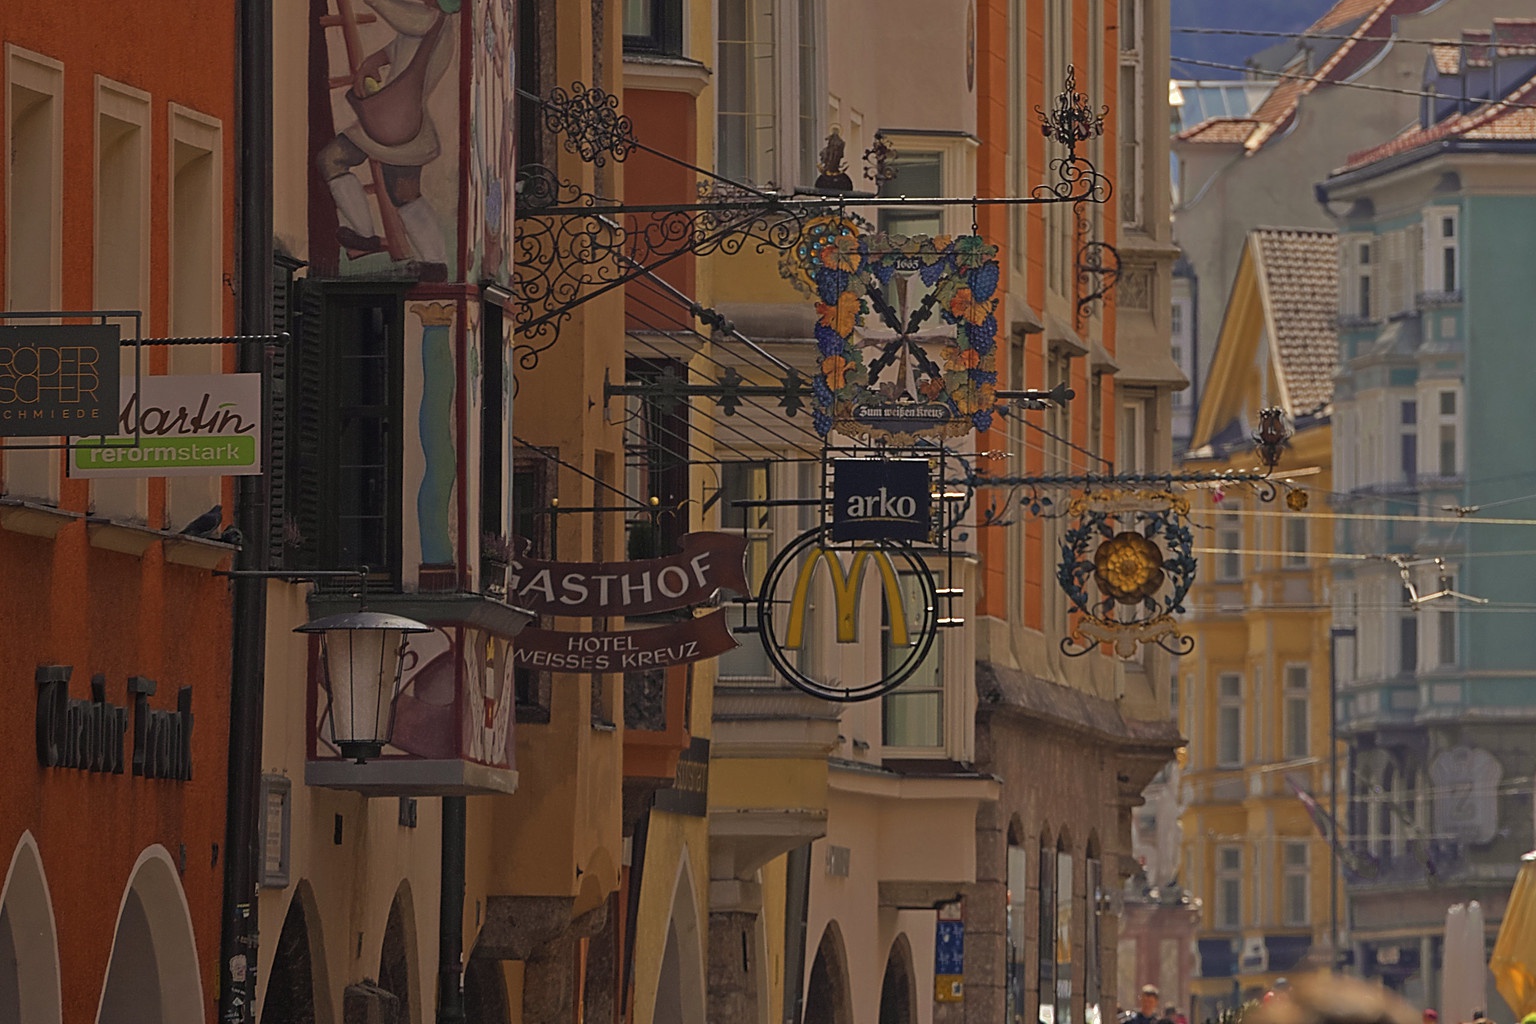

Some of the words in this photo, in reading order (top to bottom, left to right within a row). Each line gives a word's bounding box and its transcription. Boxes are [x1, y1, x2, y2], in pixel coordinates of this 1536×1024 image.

[3, 409, 100, 420] CHMIEDE
[859, 405, 882, 418] Zum
[917, 405, 943, 418] Kreuz
[90, 443, 240, 463] reformstark
[847, 486, 916, 518] arko
[568, 636, 639, 652] HOTEL
[622, 641, 700, 668] KREUZ
